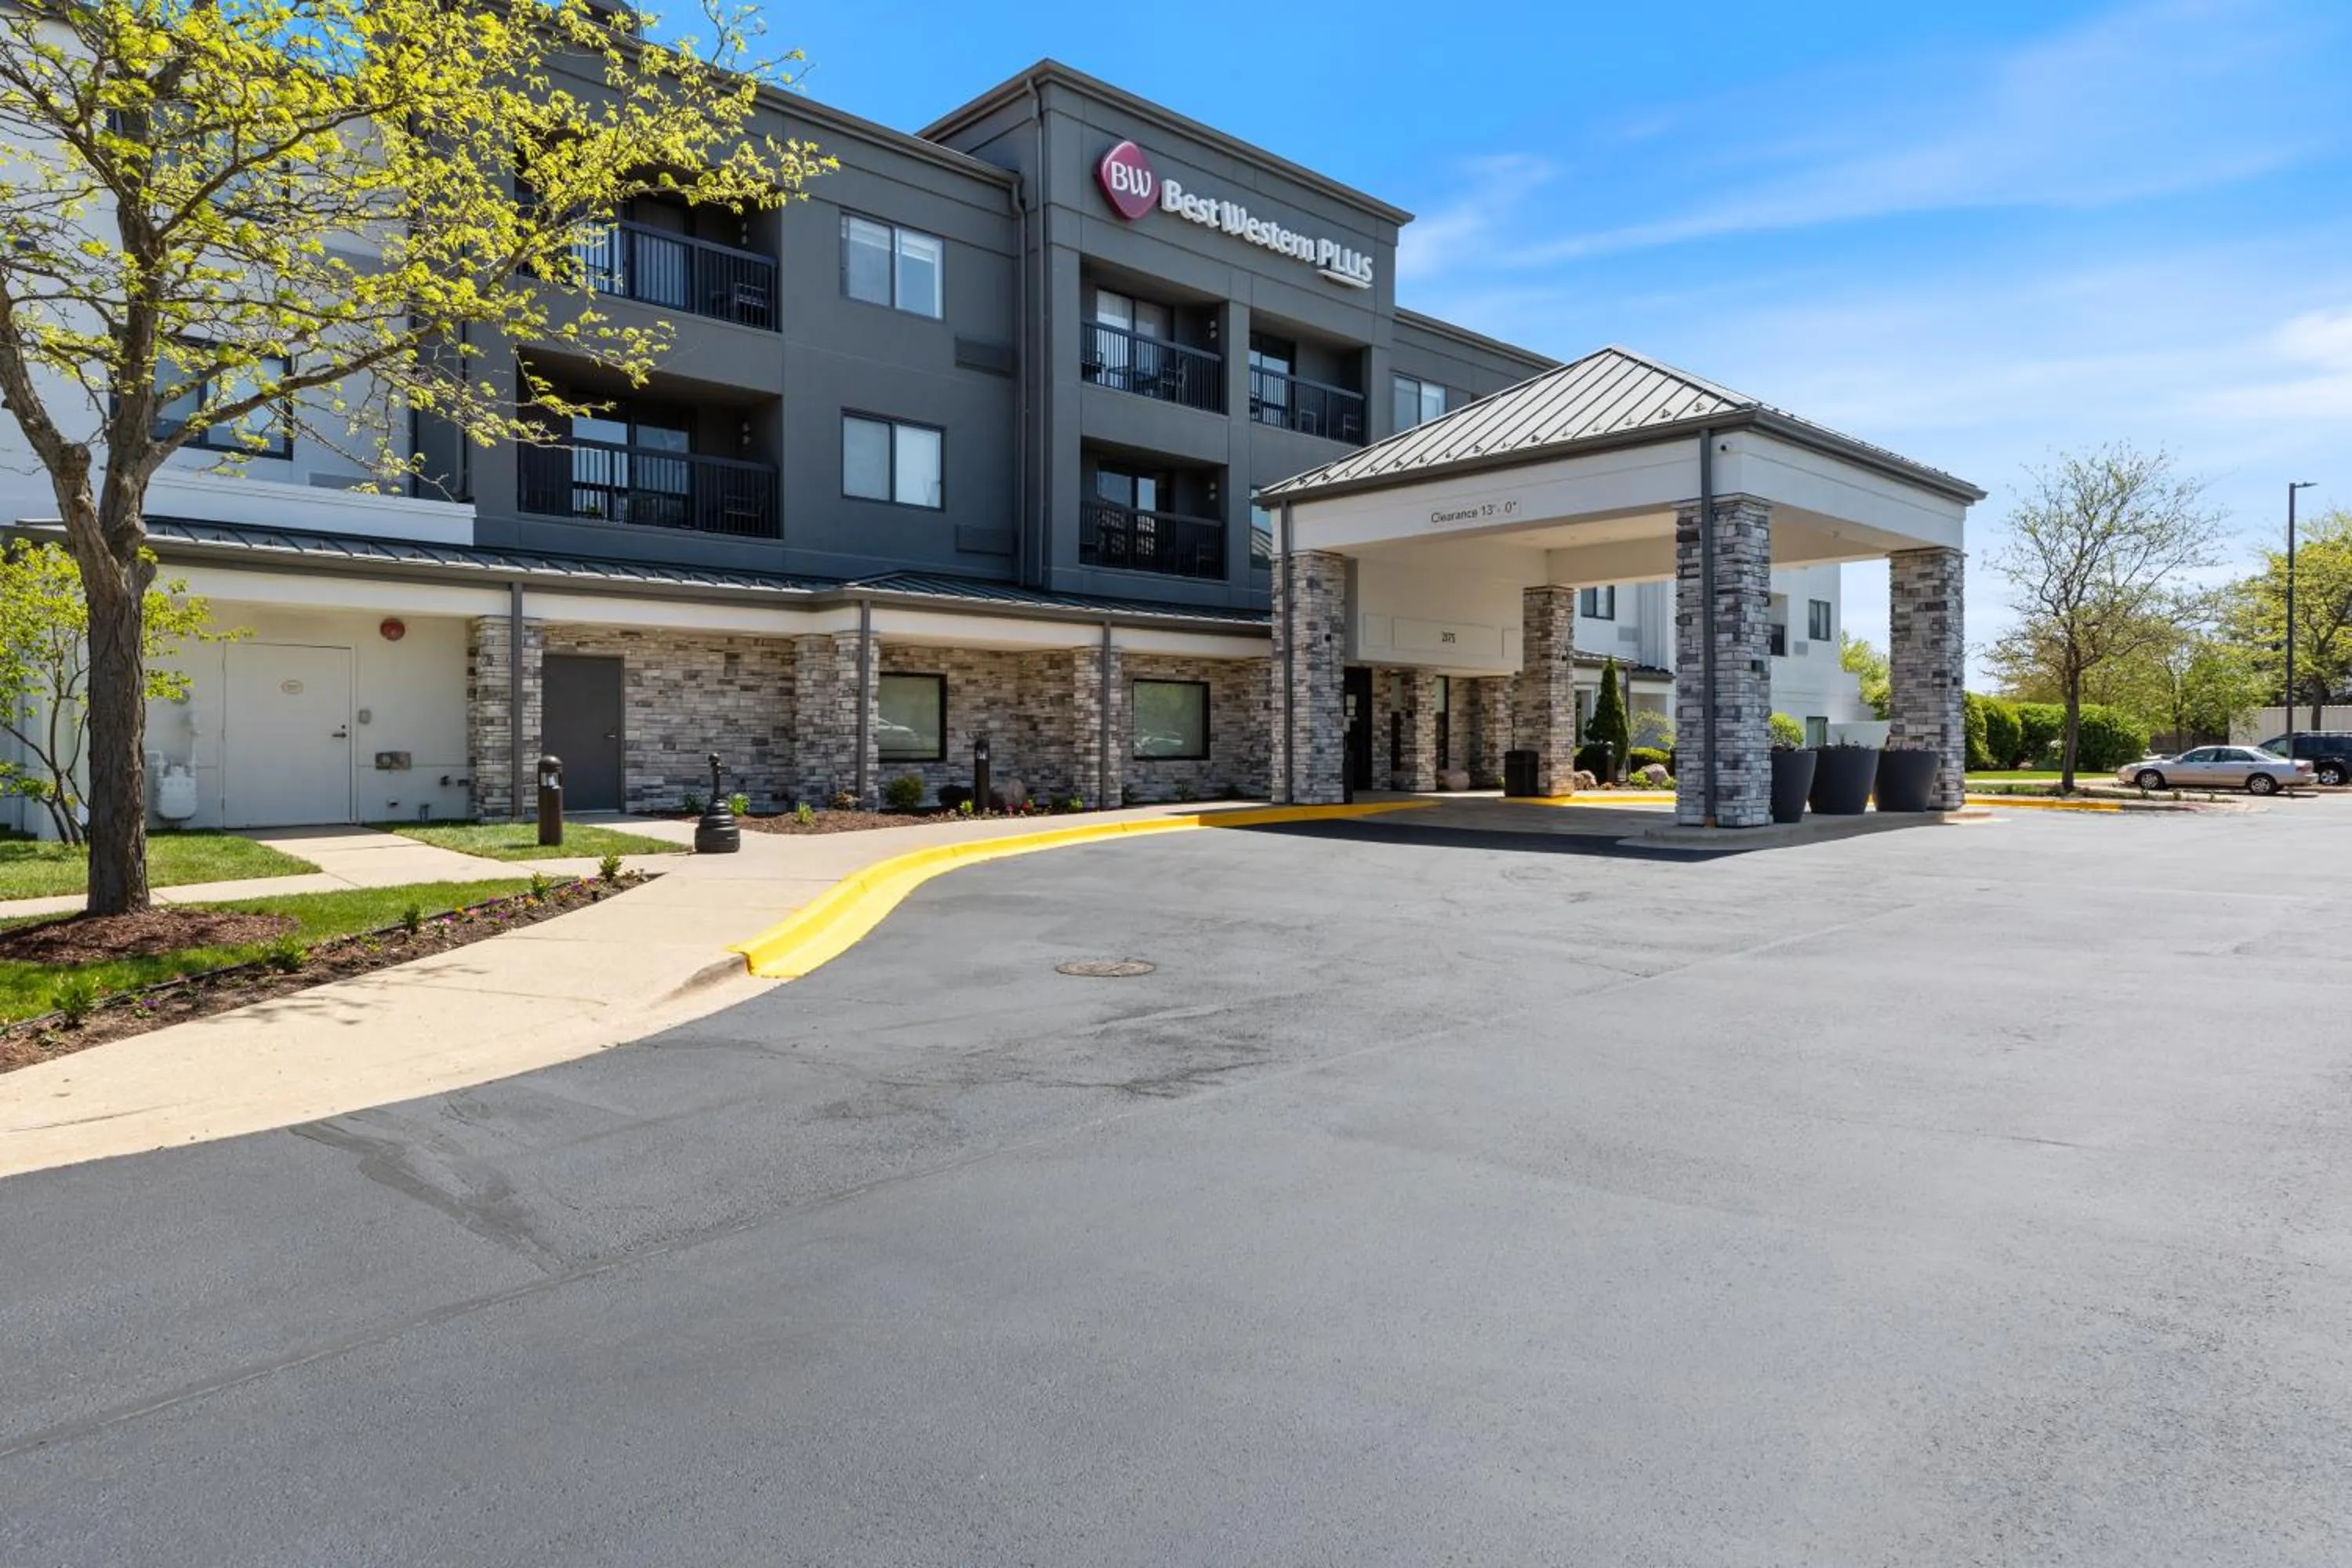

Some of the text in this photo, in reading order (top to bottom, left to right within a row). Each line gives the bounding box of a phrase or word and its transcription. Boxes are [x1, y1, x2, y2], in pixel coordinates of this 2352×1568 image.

[1110, 161, 1152, 198] BW
[1161, 178, 1374, 282] Best Western PLUS
[1431, 508, 1479, 524] Clearance
